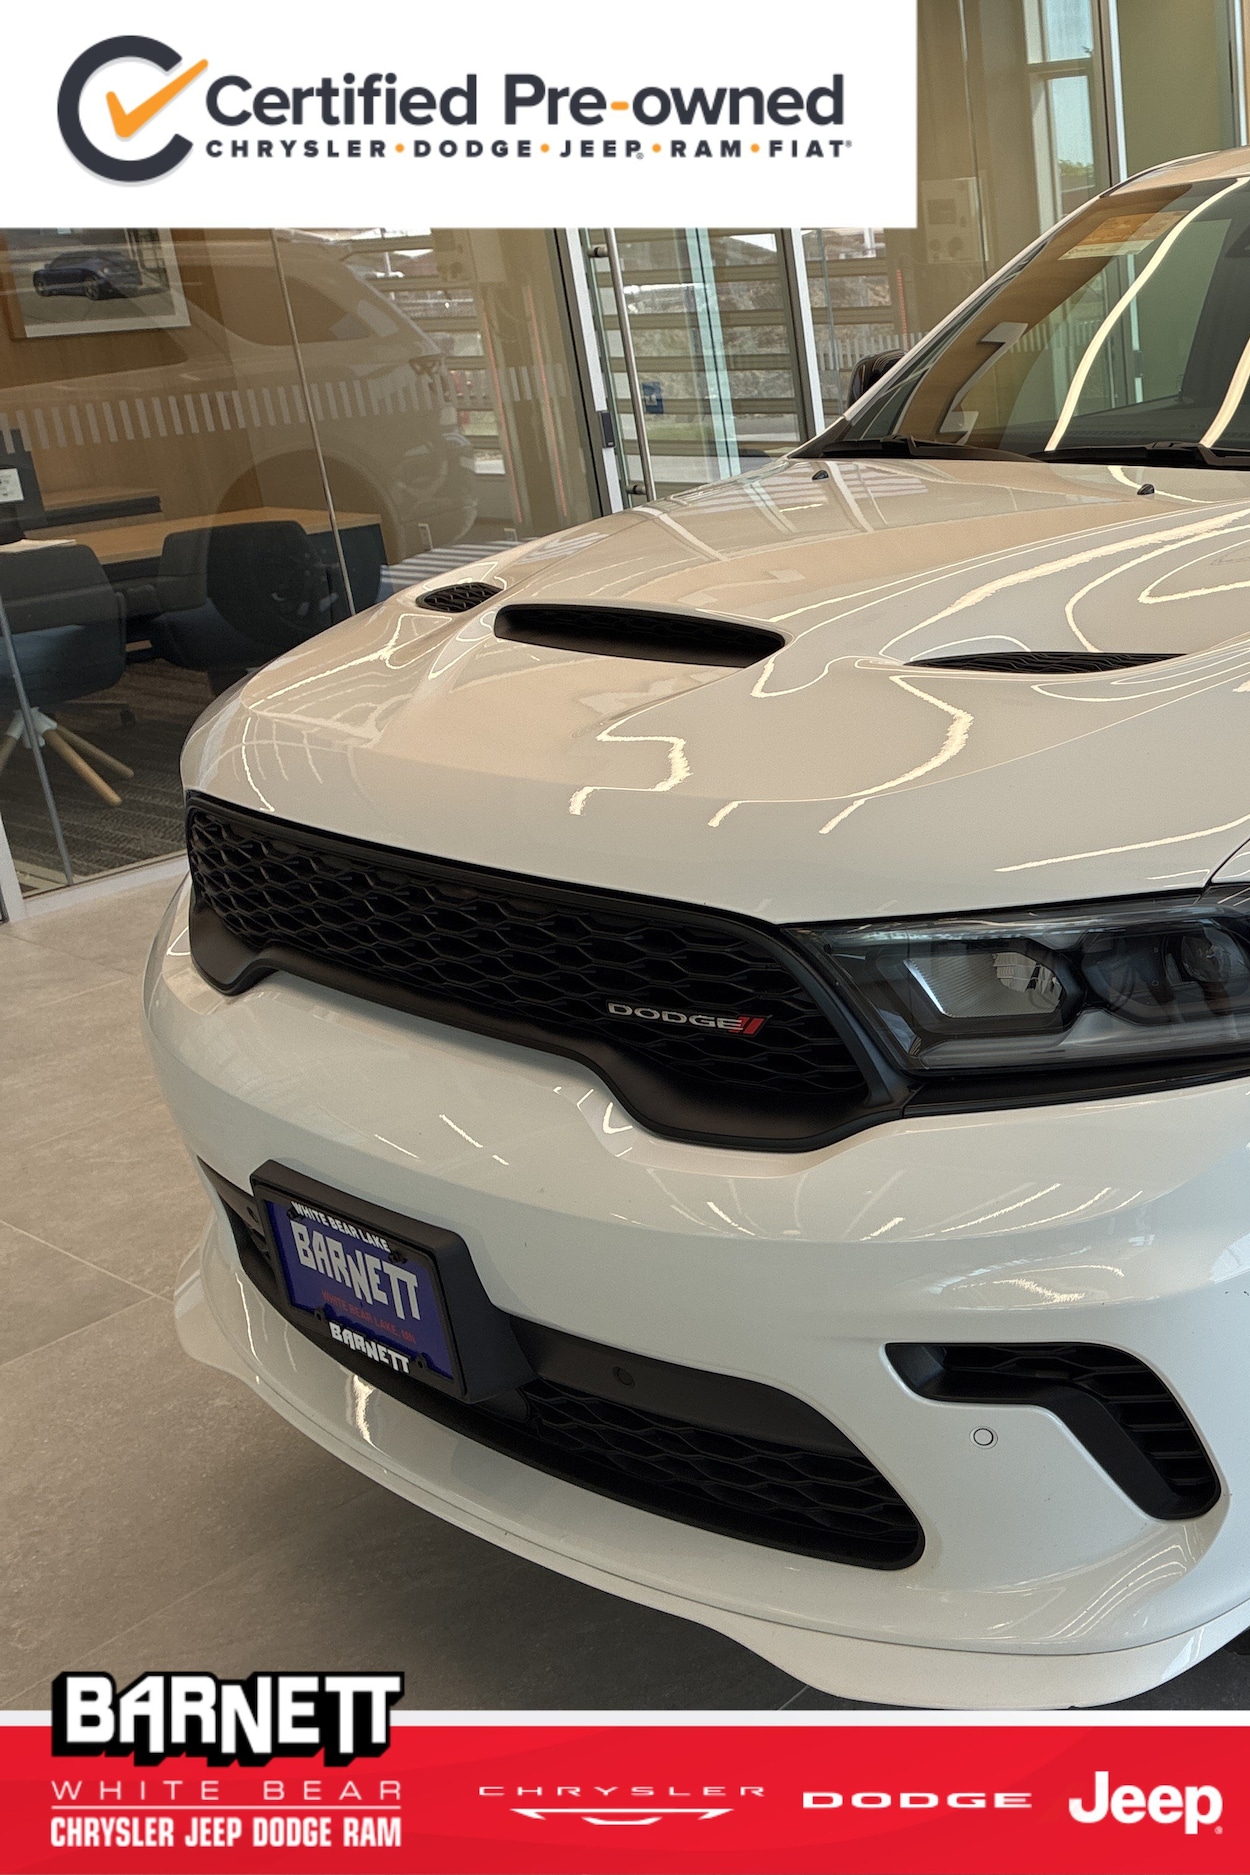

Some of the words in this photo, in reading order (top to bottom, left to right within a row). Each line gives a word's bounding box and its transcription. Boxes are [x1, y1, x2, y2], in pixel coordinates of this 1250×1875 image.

[607, 1002, 744, 1031] DODGE
[291, 1200, 331, 1229] WHITE
[329, 1214, 360, 1242] BEAR
[360, 1229, 391, 1253] LAKE
[289, 1219, 421, 1321] BARNETT
[328, 1321, 410, 1374] BARNETT
